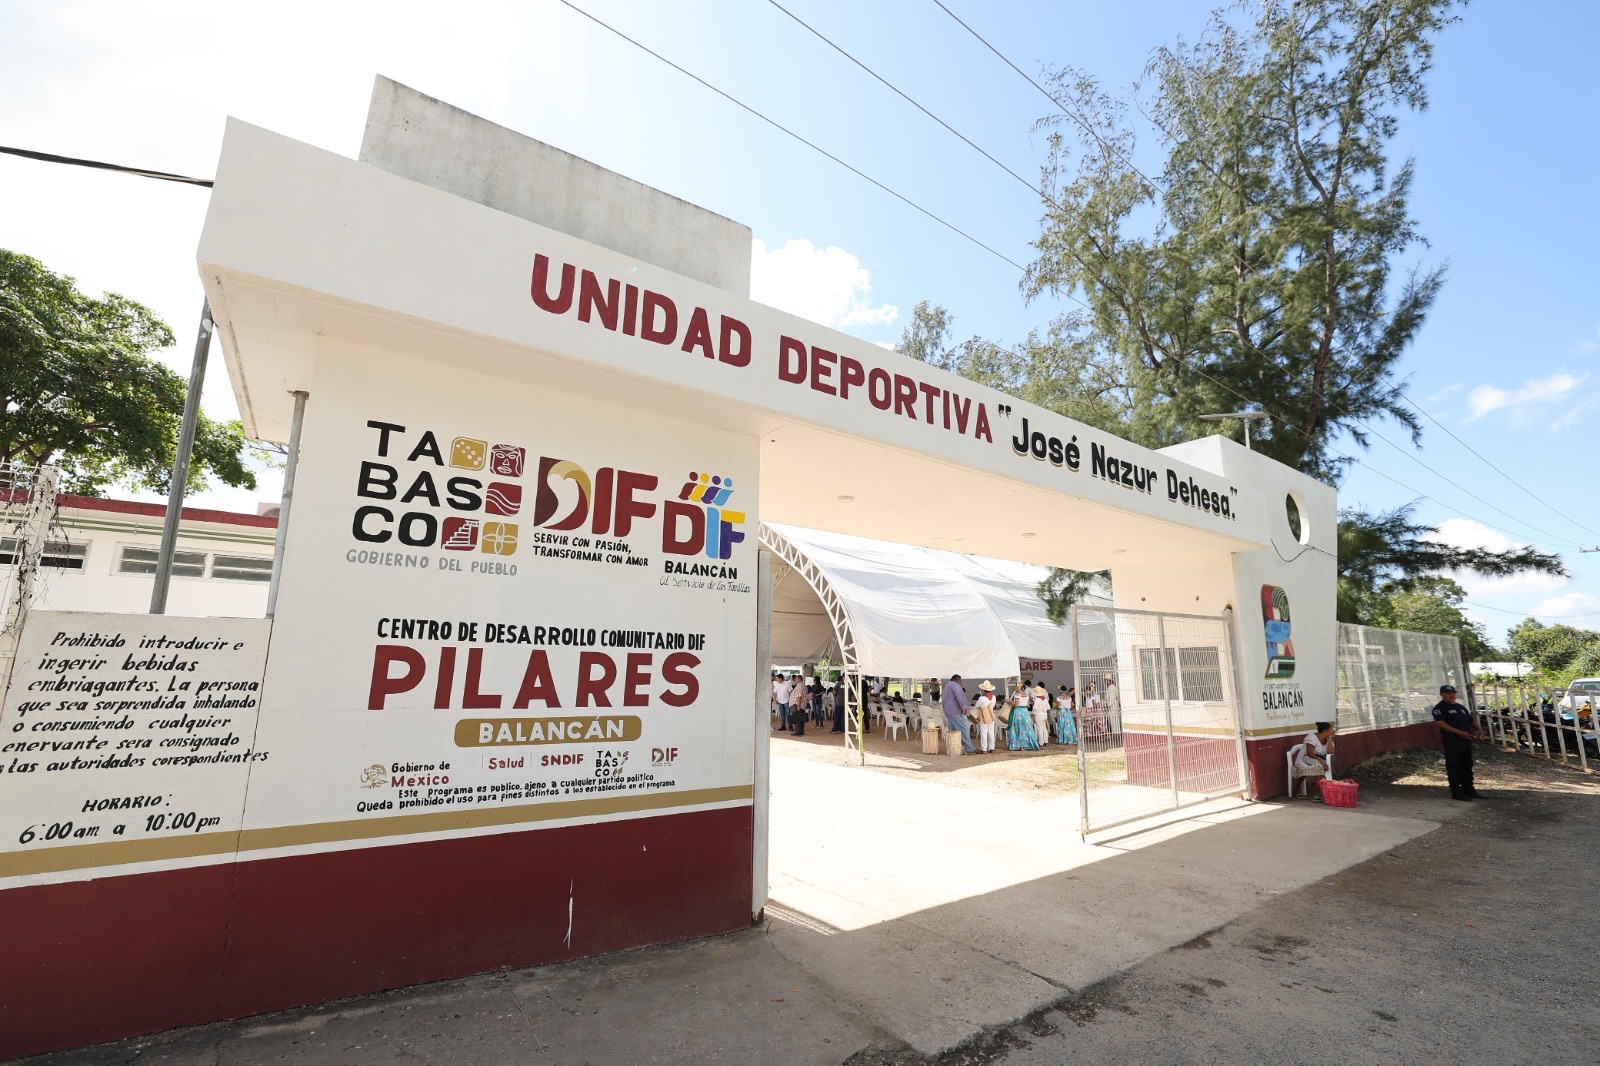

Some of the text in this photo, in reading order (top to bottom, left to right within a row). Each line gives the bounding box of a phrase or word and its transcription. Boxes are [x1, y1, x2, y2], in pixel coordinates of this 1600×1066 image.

[531, 253, 752, 368] UNIDAD
[778, 335, 993, 443] DEPORTIVA
[1092, 442, 1157, 494] Nazur
[367, 420, 444, 466] TA
[357, 461, 482, 511] BAS
[534, 456, 658, 537] DIF
[352, 506, 437, 547] CO
[662, 500, 745, 560] DIF
[534, 533, 632, 554] SERVIR CON PASIÓN,
[346, 549, 517, 576] GOBIERNO DEL PUEBLO
[533, 546, 648, 566] TRANSFORMAR CON AMOR
[664, 560, 737, 579] BALANCÁN
[50, 632, 125, 648] Prohibido
[139, 635, 228, 650] introducir
[377, 618, 705, 650] CENTRO DE DESARROLLO COMUNITARIO DIF
[38, 653, 198, 674] ingerir bebidas
[1020, 660, 1053, 671] LARES
[28, 675, 258, 697] embriagantes. La persona
[368, 645, 701, 710] PILARES
[18, 693, 256, 717] que sea sorprendida inhalando
[1263, 688, 1303, 710] BALANCÁN
[12, 714, 231, 733] o consumiendo cualquier
[478, 716, 624, 744] BALANCÁN
[2, 733, 239, 752] enervante sera consignado
[8, 758, 39, 773] las
[47, 753, 146, 772] autoridades
[152, 749, 269, 766] corespondientes
[489, 757, 524, 769] Salud
[541, 754, 584, 767] SNDIF
[596, 758, 618, 767] BAS
[652, 748, 678, 762] DIF
[392, 761, 450, 772] Gobierno de
[595, 769, 609, 777] CO
[391, 774, 449, 787] México
[399, 790, 418, 798] Este
[428, 786, 473, 797] programa
[525, 781, 546, 790] ajeno
[561, 778, 596, 789] cualquier
[599, 776, 624, 786] partido
[627, 773, 653, 783] politico
[357, 800, 392, 812] Queda
[399, 797, 444, 809] prohibido
[478, 795, 496, 803] para
[501, 792, 522, 802] fines
[525, 788, 559, 797] distintos
[585, 783, 626, 793] establecido
[647, 780, 675, 788] programa
[113, 823, 126, 835] a
